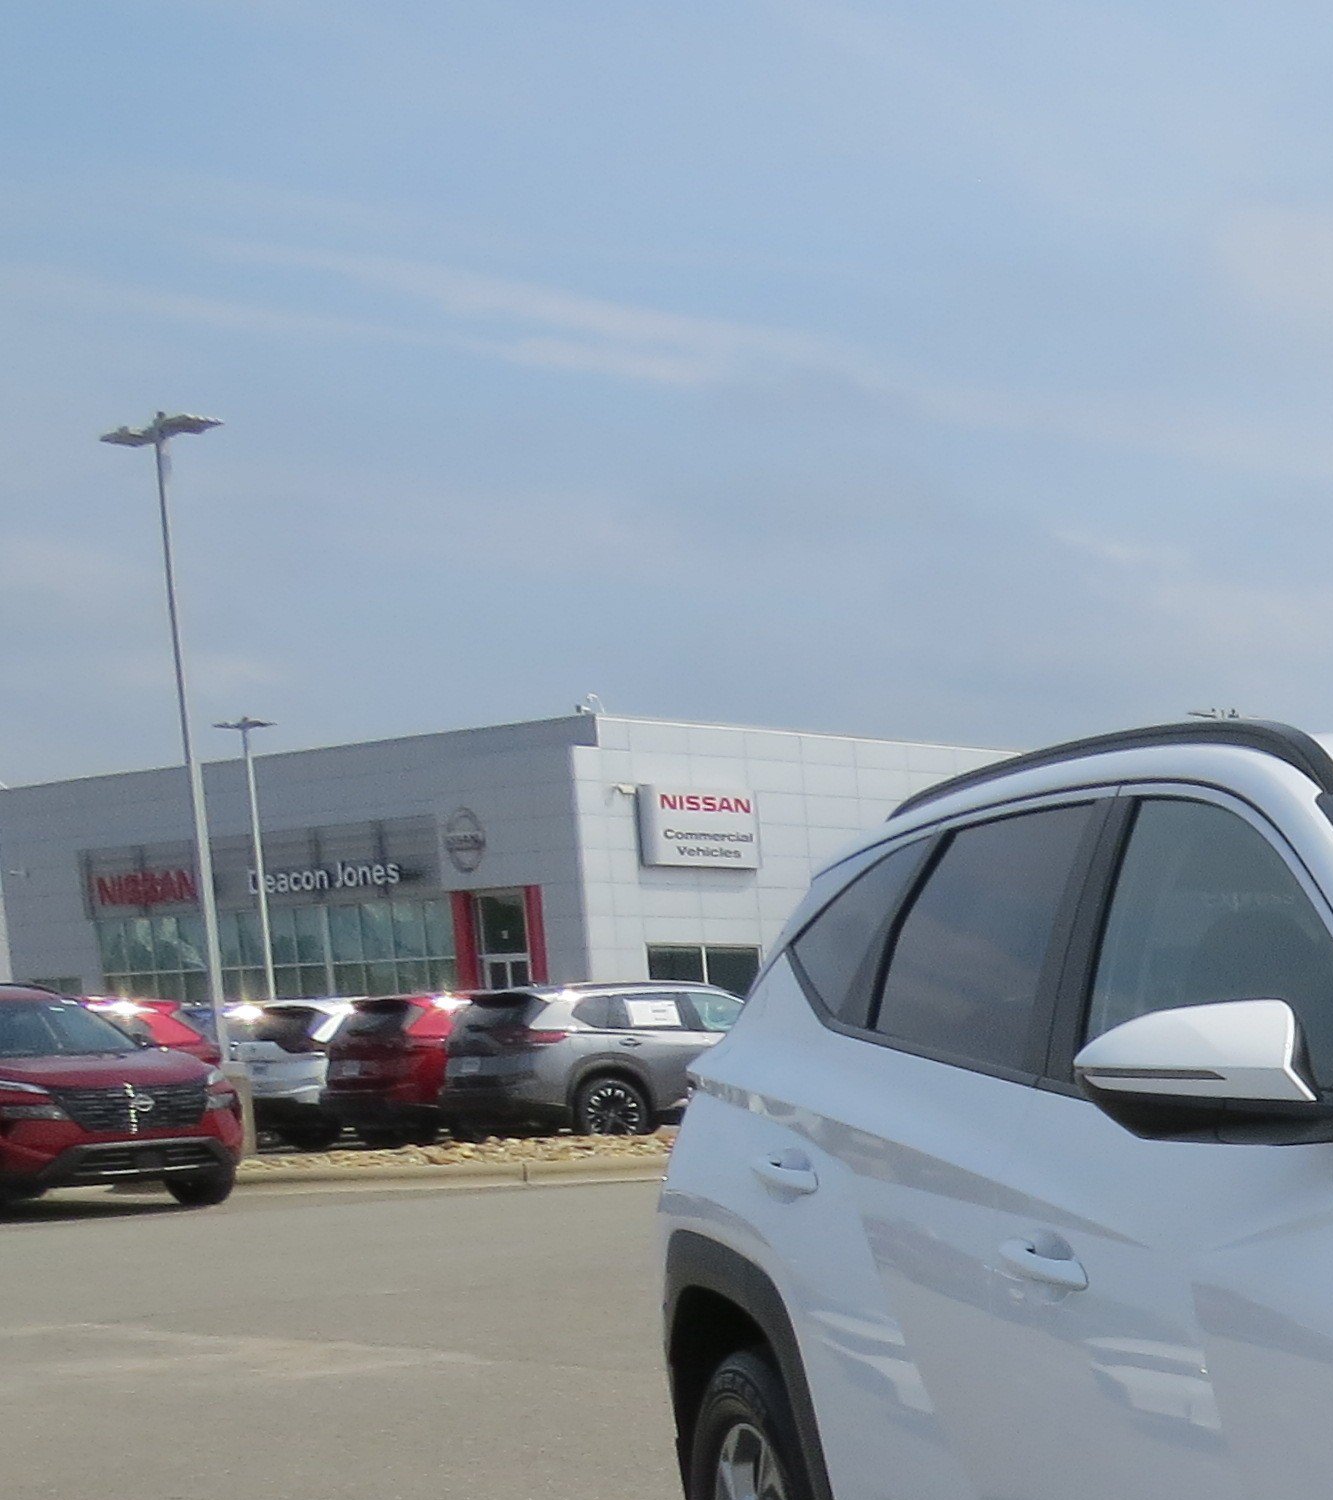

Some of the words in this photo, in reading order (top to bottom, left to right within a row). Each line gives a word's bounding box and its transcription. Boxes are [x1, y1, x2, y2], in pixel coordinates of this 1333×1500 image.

[659, 794, 752, 814] NISSAN
[663, 828, 754, 843] Commercial
[676, 845, 742, 859] Vehicles
[335, 861, 400, 889] Jones
